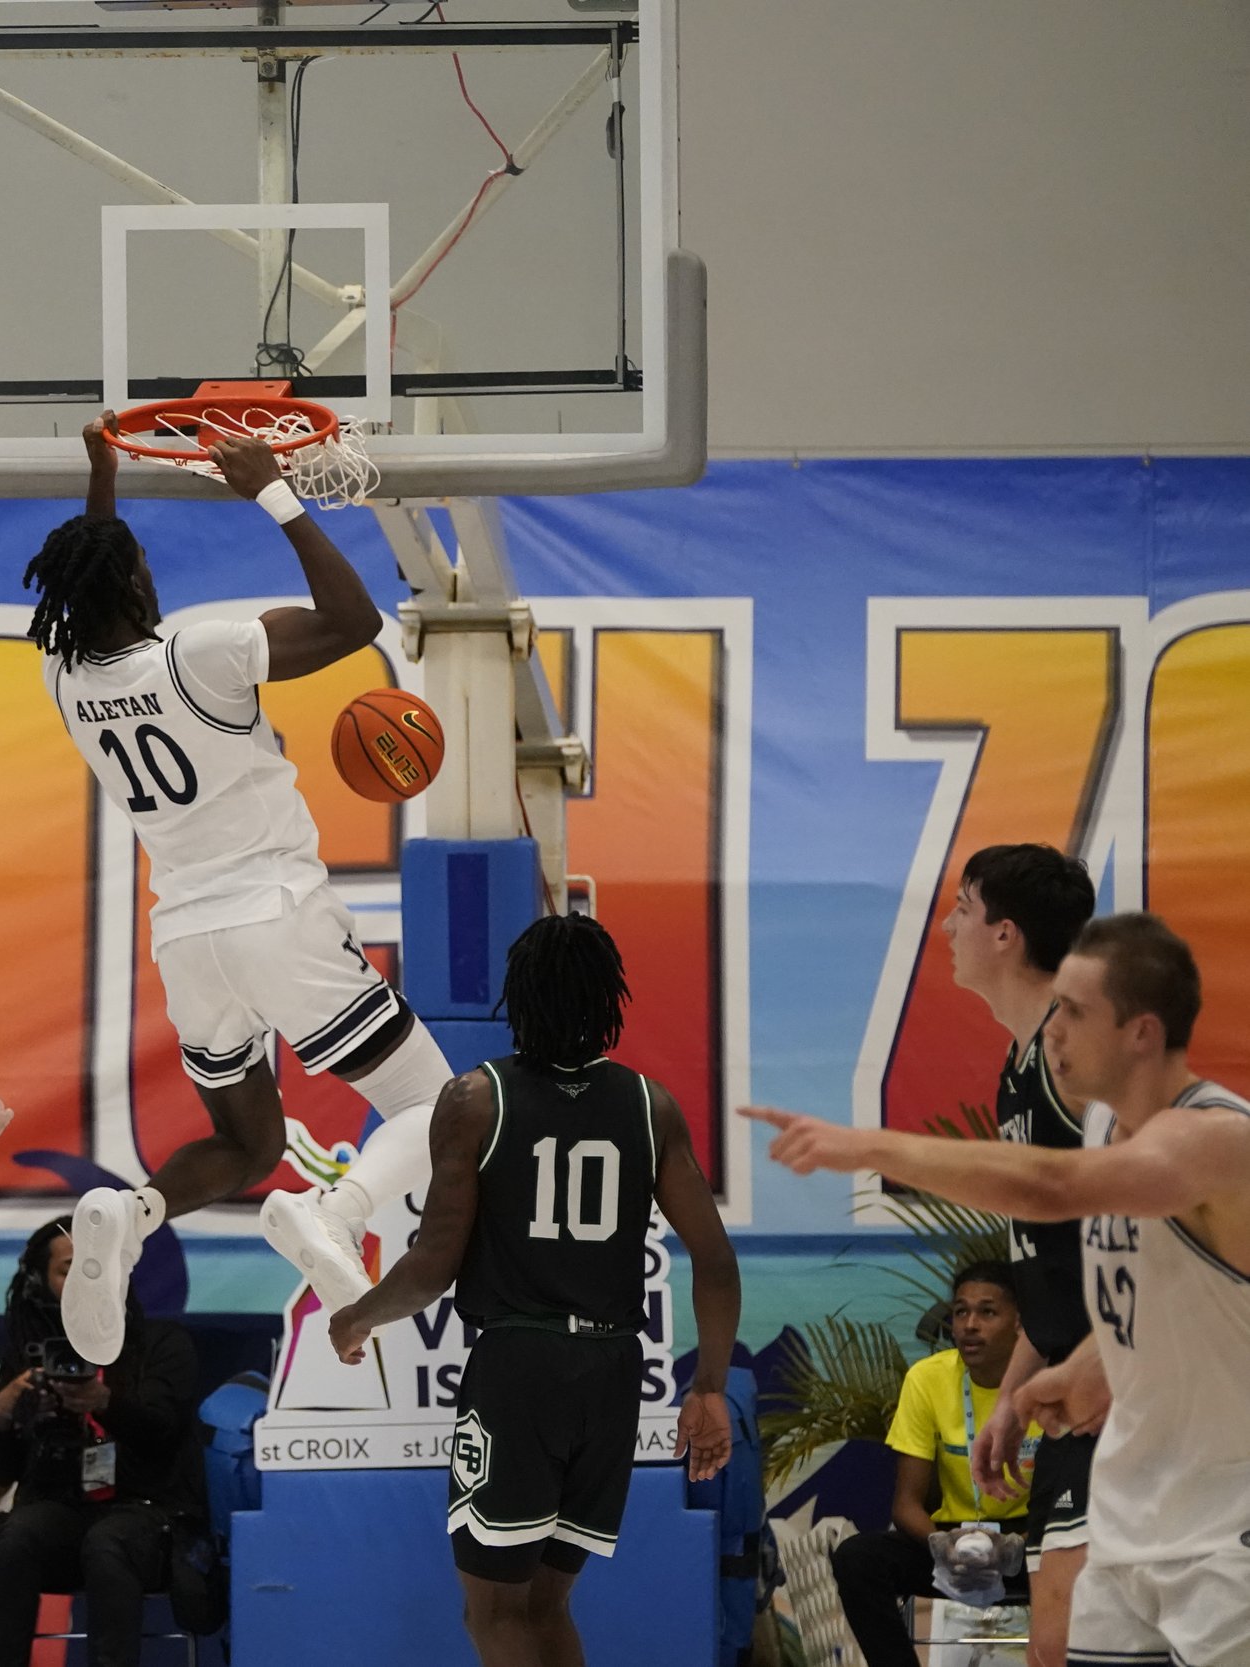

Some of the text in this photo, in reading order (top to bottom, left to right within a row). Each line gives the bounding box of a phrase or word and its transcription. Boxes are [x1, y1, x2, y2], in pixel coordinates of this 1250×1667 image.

[76, 692, 163, 723] ALETAN
[98, 723, 198, 812] 10
[376, 730, 421, 785] ELITE
[341, 933, 370, 974] Y
[528, 1137, 621, 1241] 10
[1096, 1265, 1137, 1350] 42
[261, 1438, 369, 1461] st CROIX
[403, 1441, 422, 1457] st
